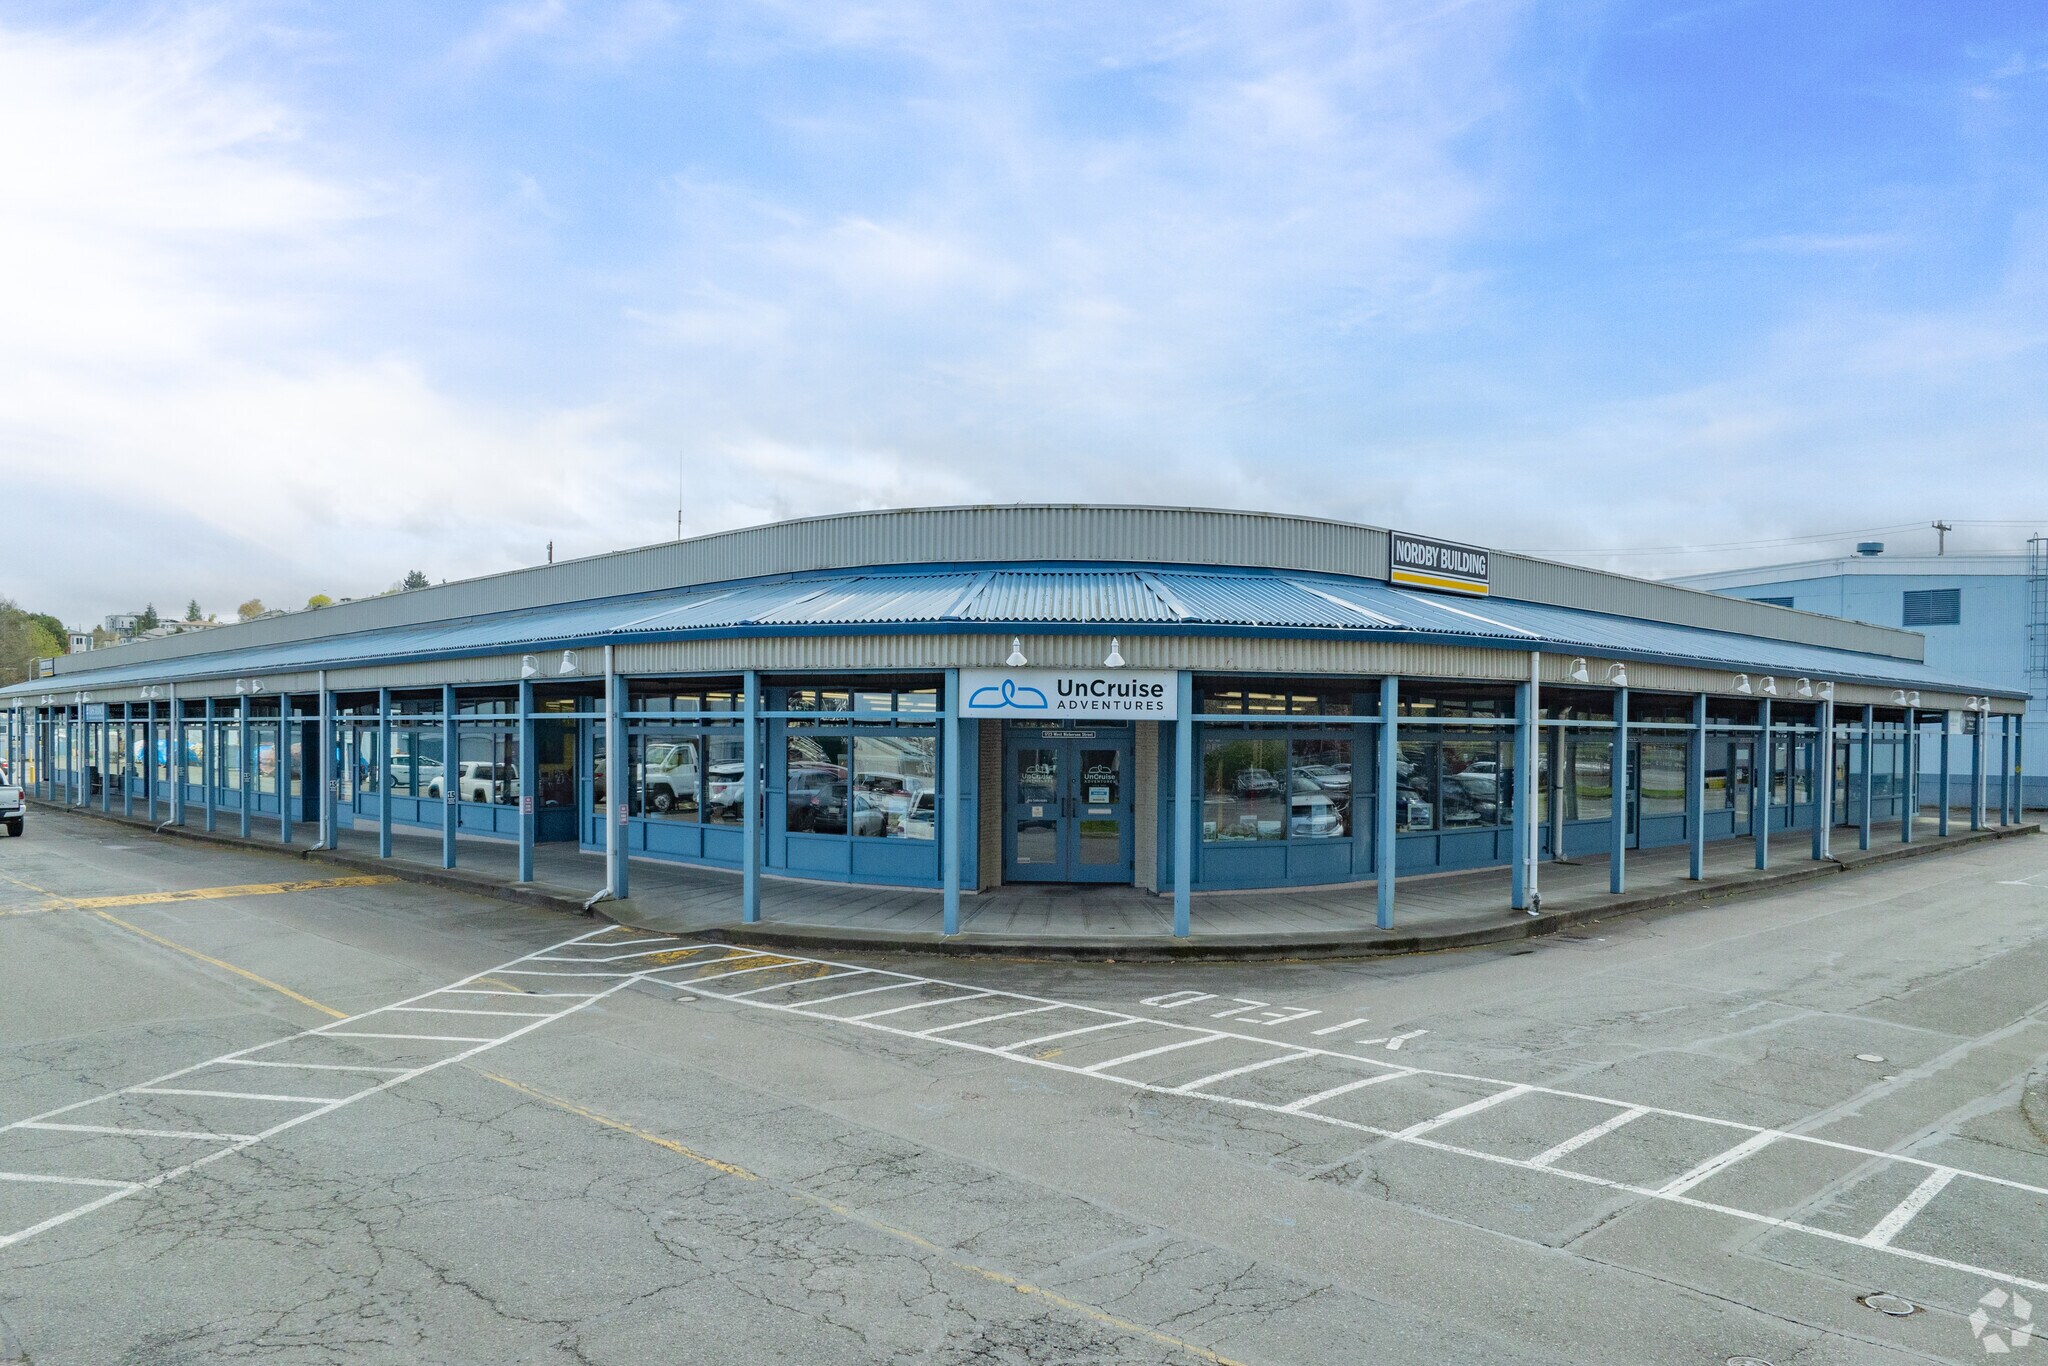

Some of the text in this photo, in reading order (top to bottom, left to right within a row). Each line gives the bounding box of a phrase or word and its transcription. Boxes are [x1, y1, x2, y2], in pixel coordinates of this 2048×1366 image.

[1396, 540, 1486, 575] NORDBY BUILDING
[1057, 679, 1164, 698] UnCruise
[1057, 700, 1164, 711] ADVENTURES
[1140, 990, 1429, 1051] YIELD
